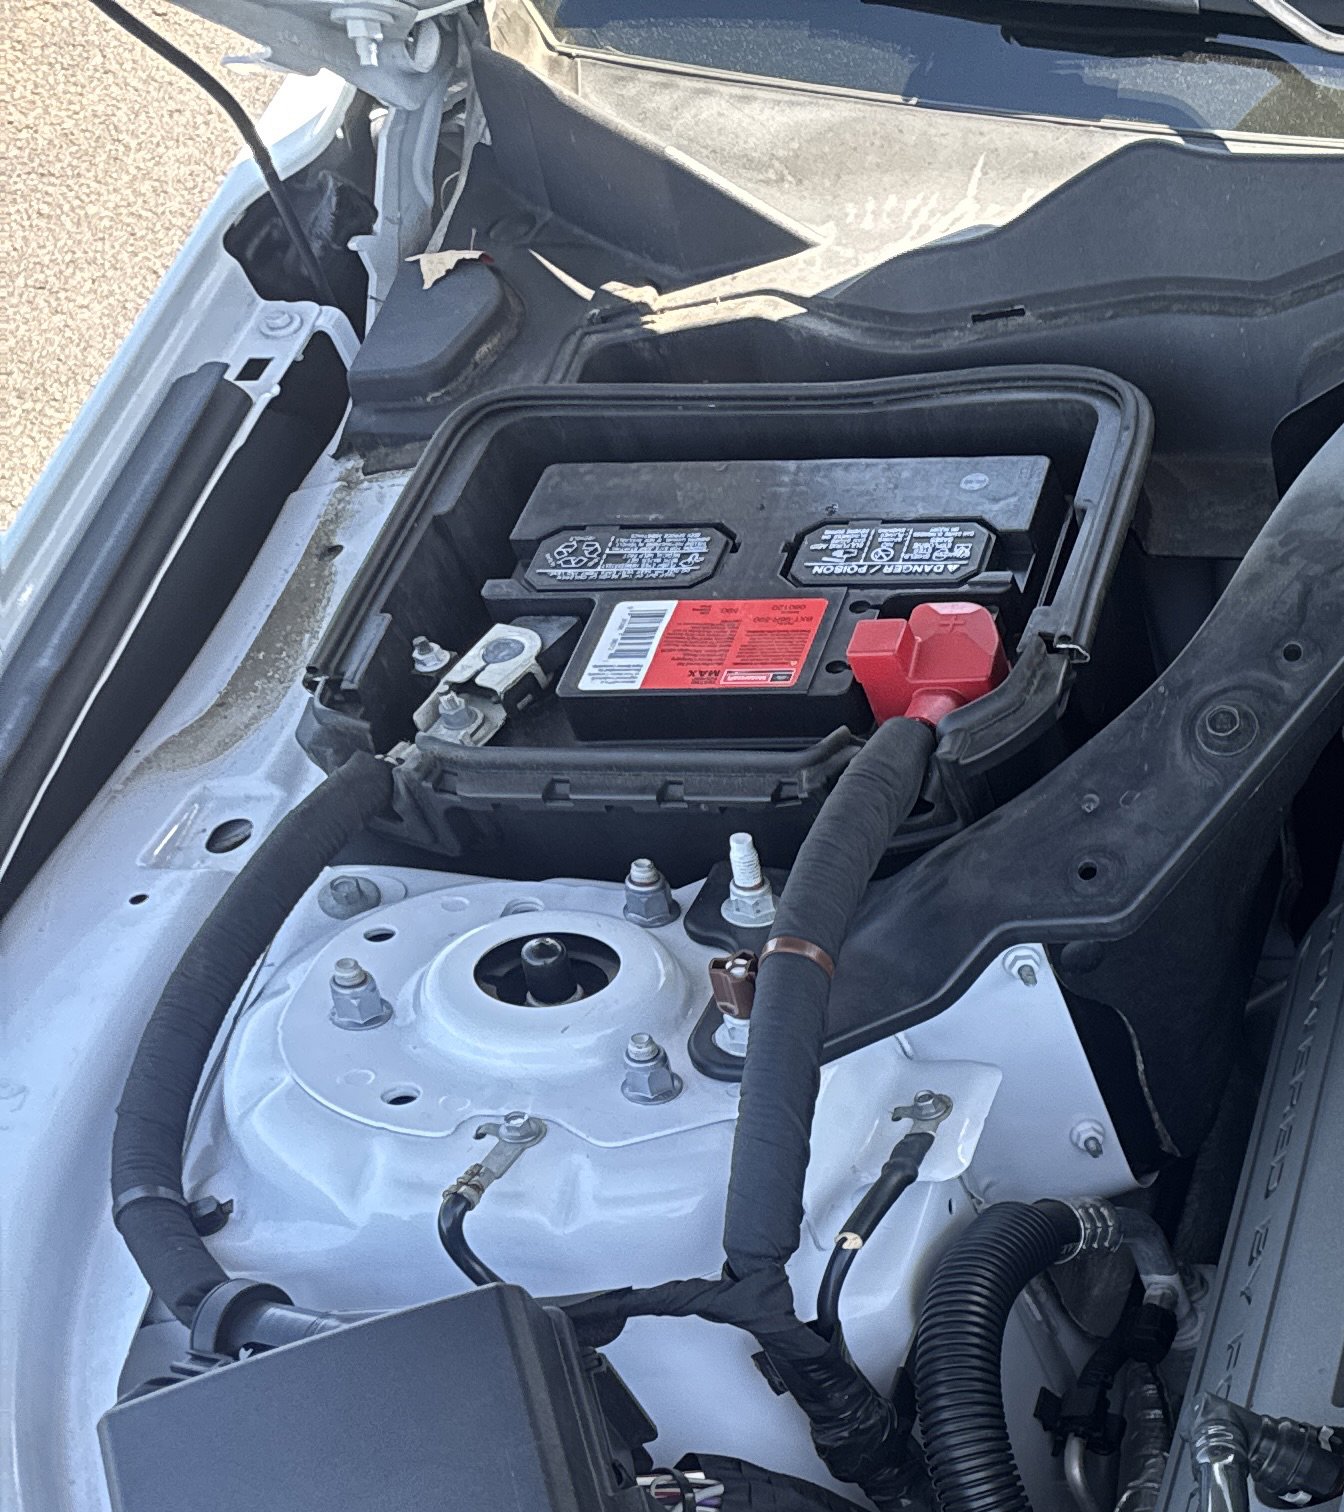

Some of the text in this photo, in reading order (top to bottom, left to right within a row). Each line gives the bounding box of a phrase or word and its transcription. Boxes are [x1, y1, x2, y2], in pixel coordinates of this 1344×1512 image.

[812, 564, 869, 575] POISON
[882, 564, 943, 574] DANGER
[688, 669, 721, 678] MAX
[1264, 901, 1344, 1201] POWERED
[1238, 1213, 1274, 1306] BY
